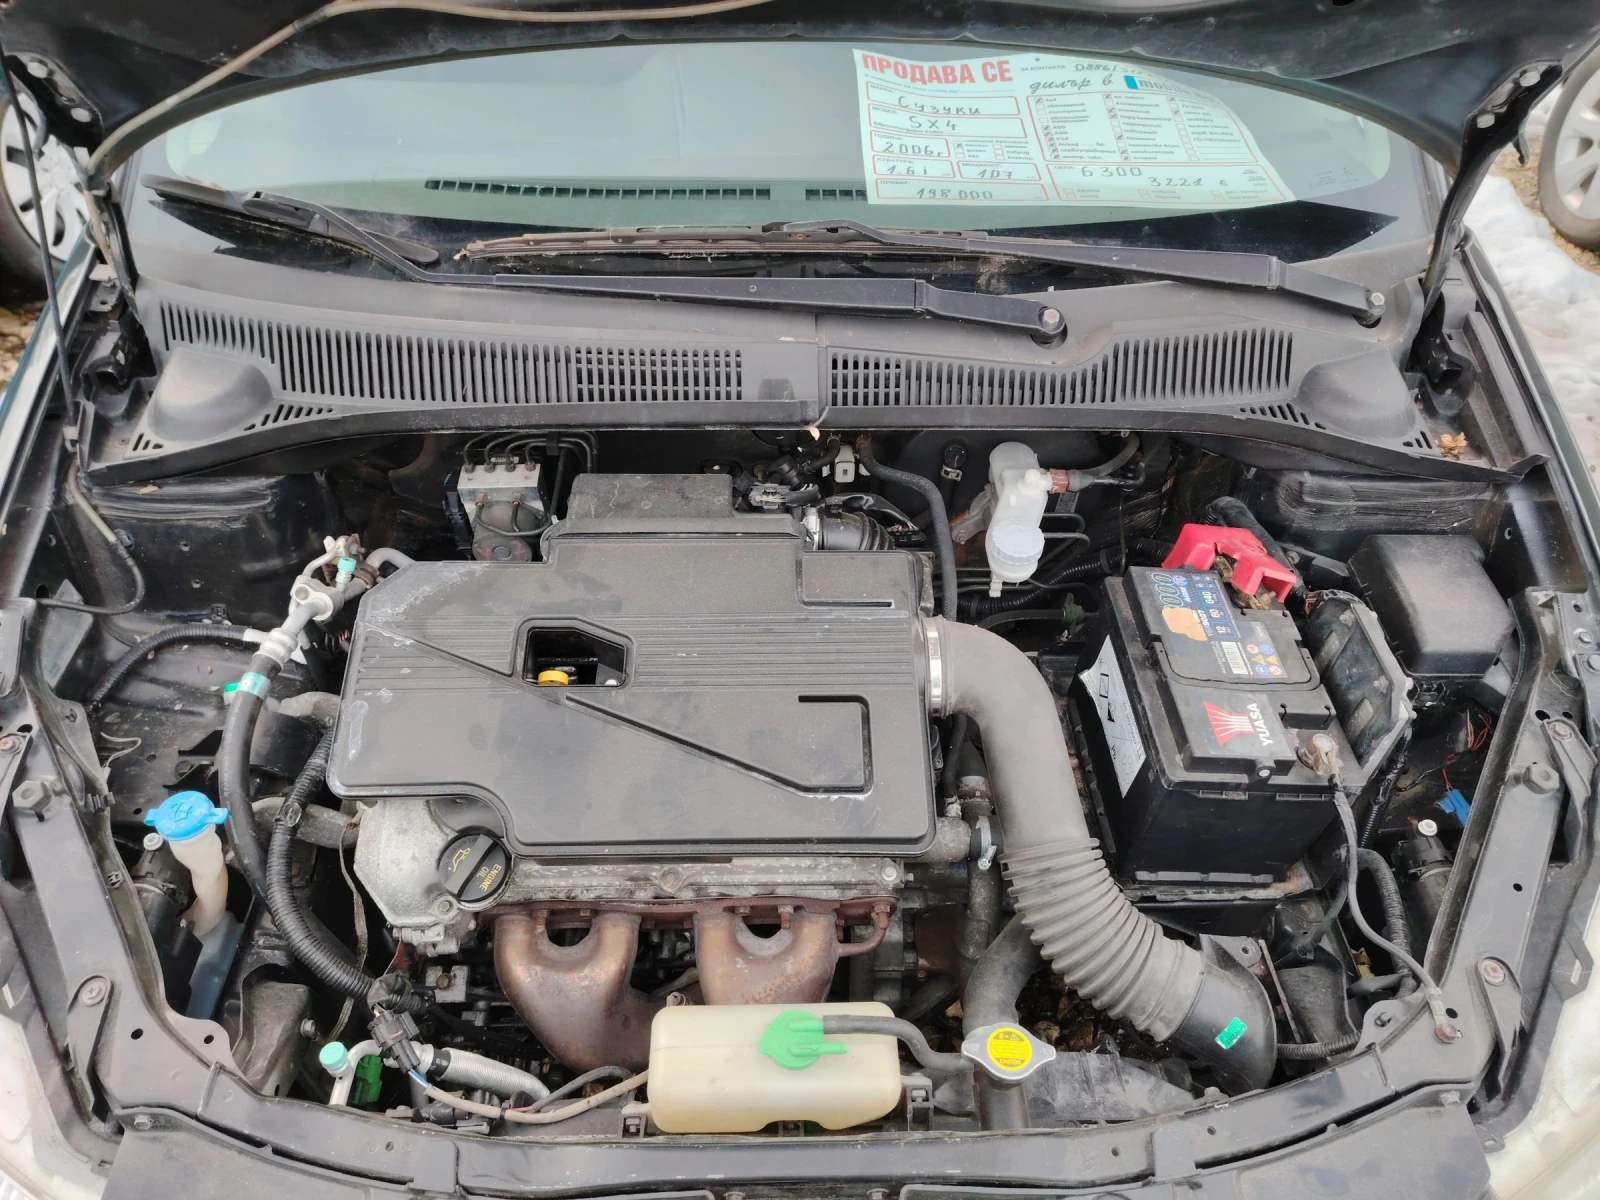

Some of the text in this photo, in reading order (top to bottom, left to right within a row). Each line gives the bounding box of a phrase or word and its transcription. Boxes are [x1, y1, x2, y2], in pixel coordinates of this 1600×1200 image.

[862, 53, 976, 85] ПРОДАВА
[981, 60, 1013, 83] СЕ
[1247, 703, 1273, 746] YUASA
[476, 866, 490, 878] OIL
[480, 863, 502, 892] ENGINE
